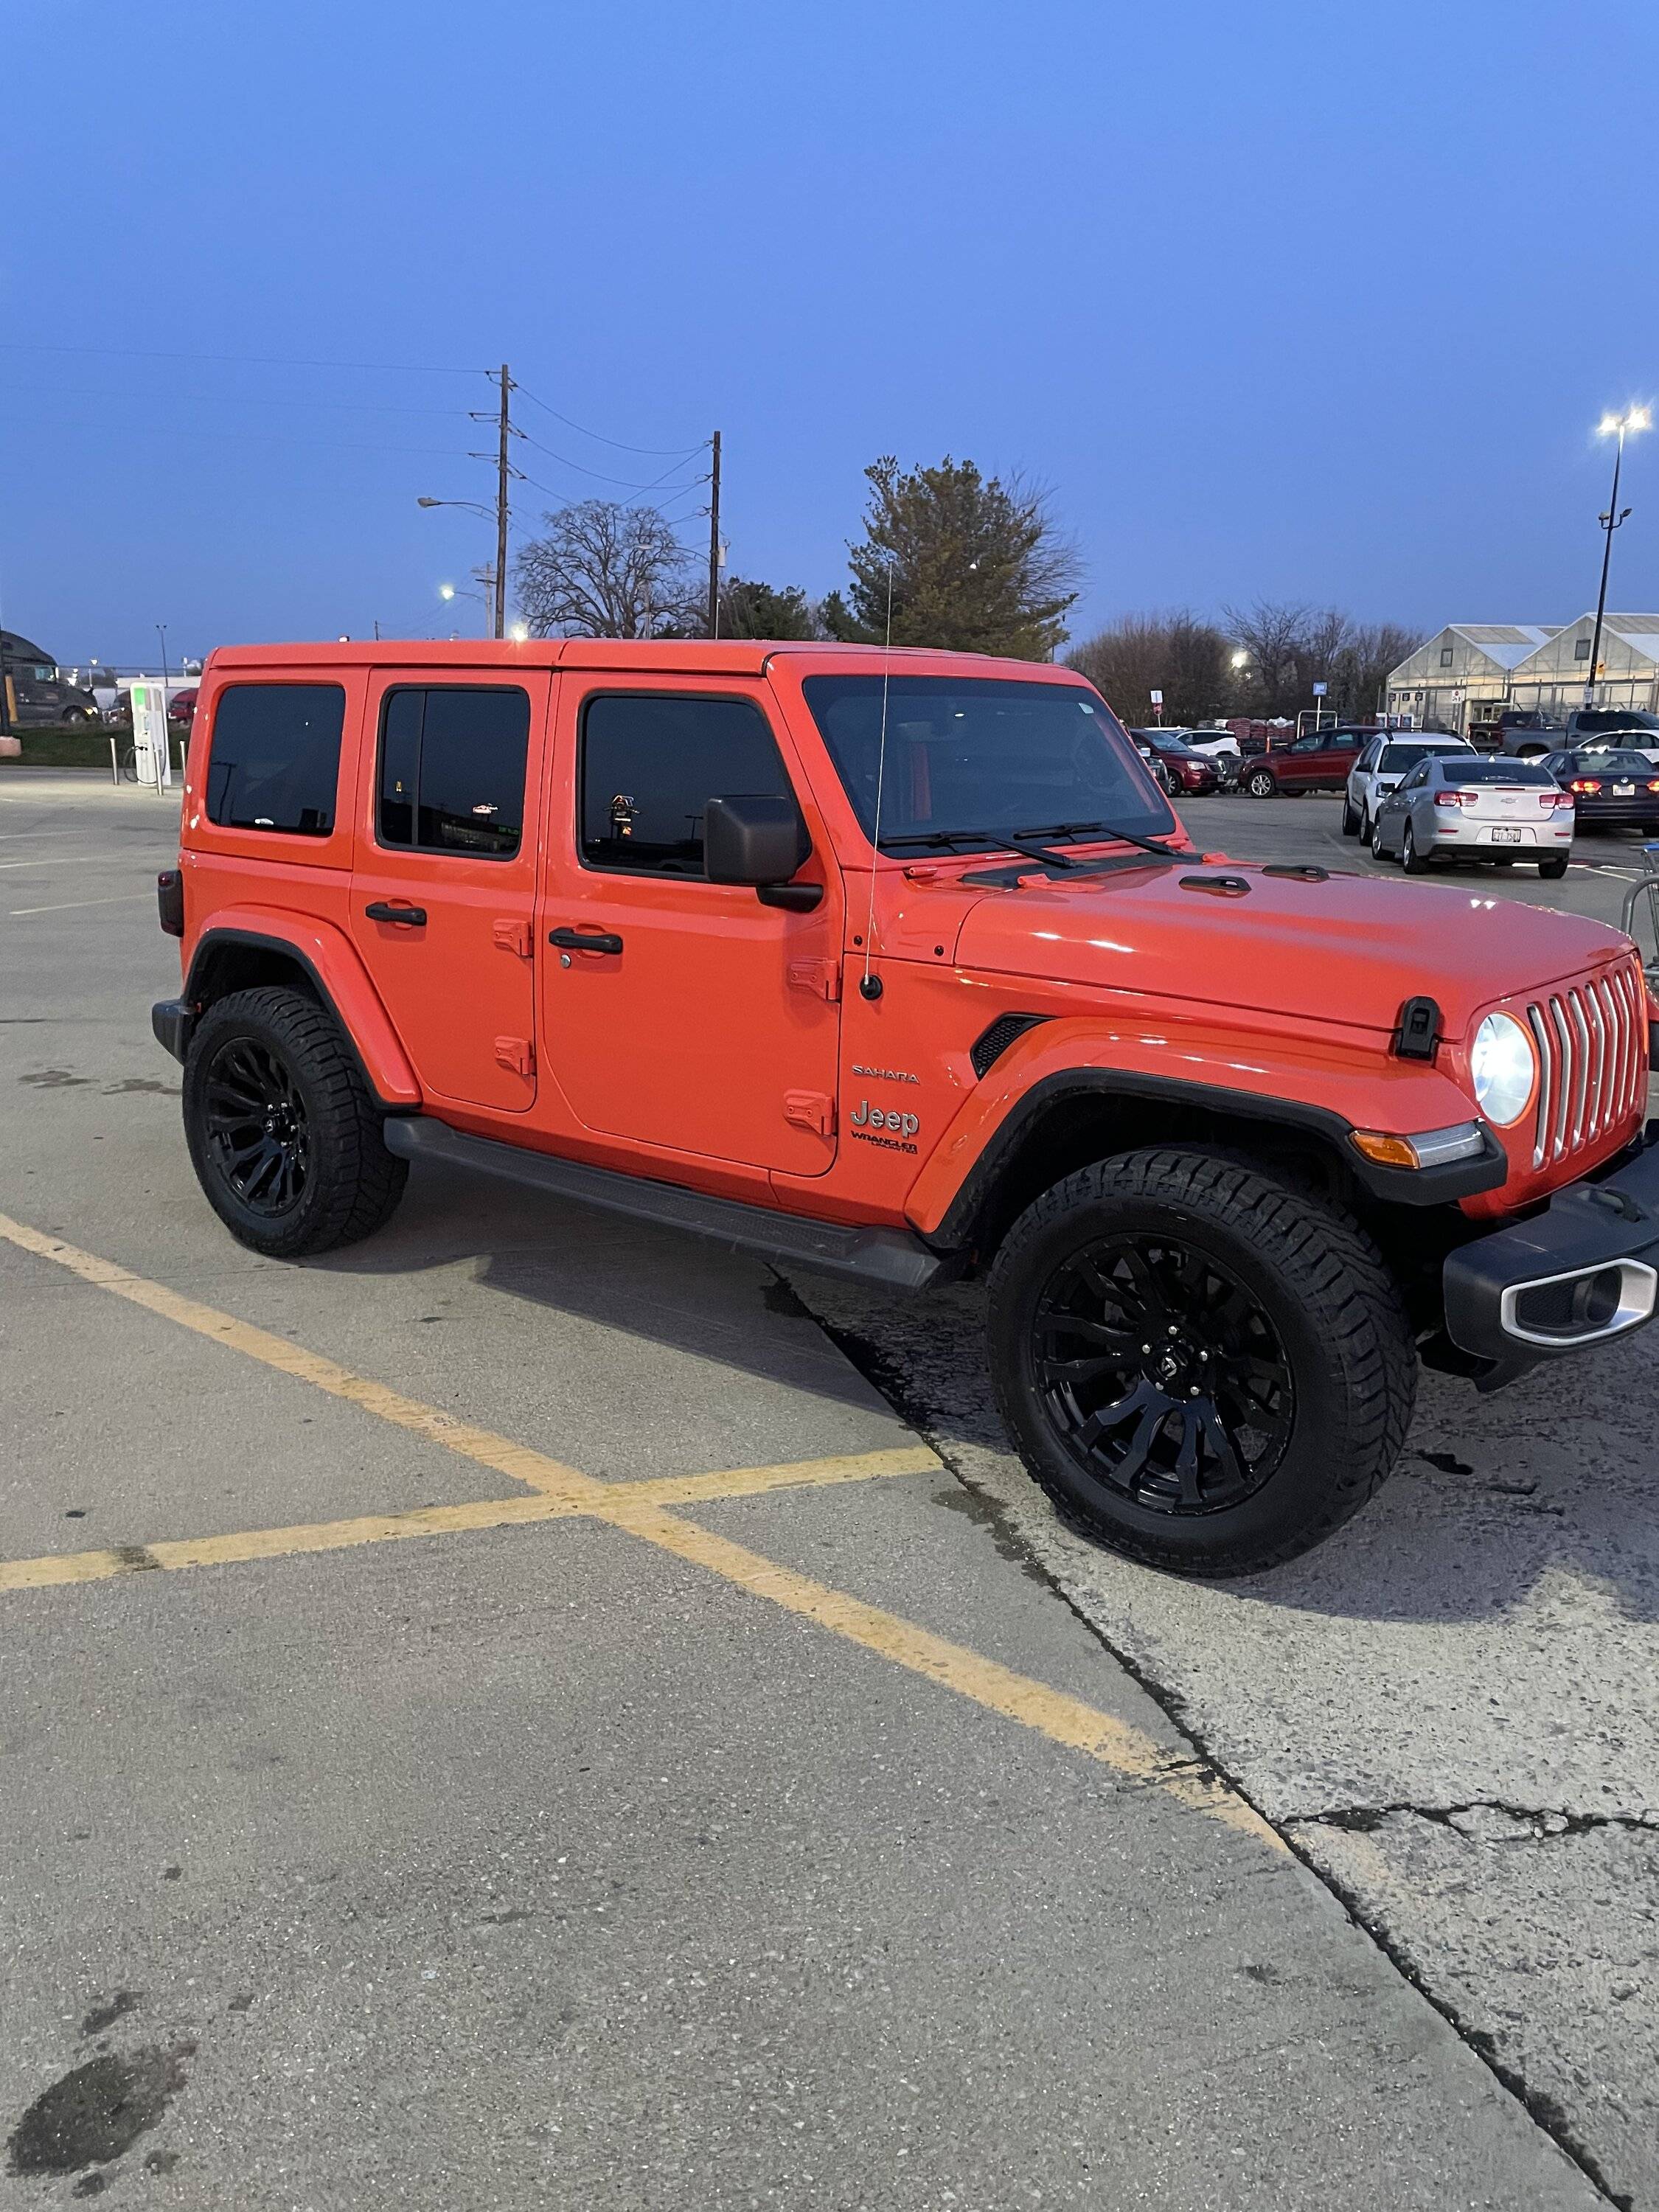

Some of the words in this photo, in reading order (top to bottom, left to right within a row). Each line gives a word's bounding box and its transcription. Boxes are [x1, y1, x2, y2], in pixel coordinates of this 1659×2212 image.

[852, 1065, 920, 1085] SAHARA
[850, 1099, 919, 1139] Jeep
[850, 1130, 918, 1151] WRANGLER
